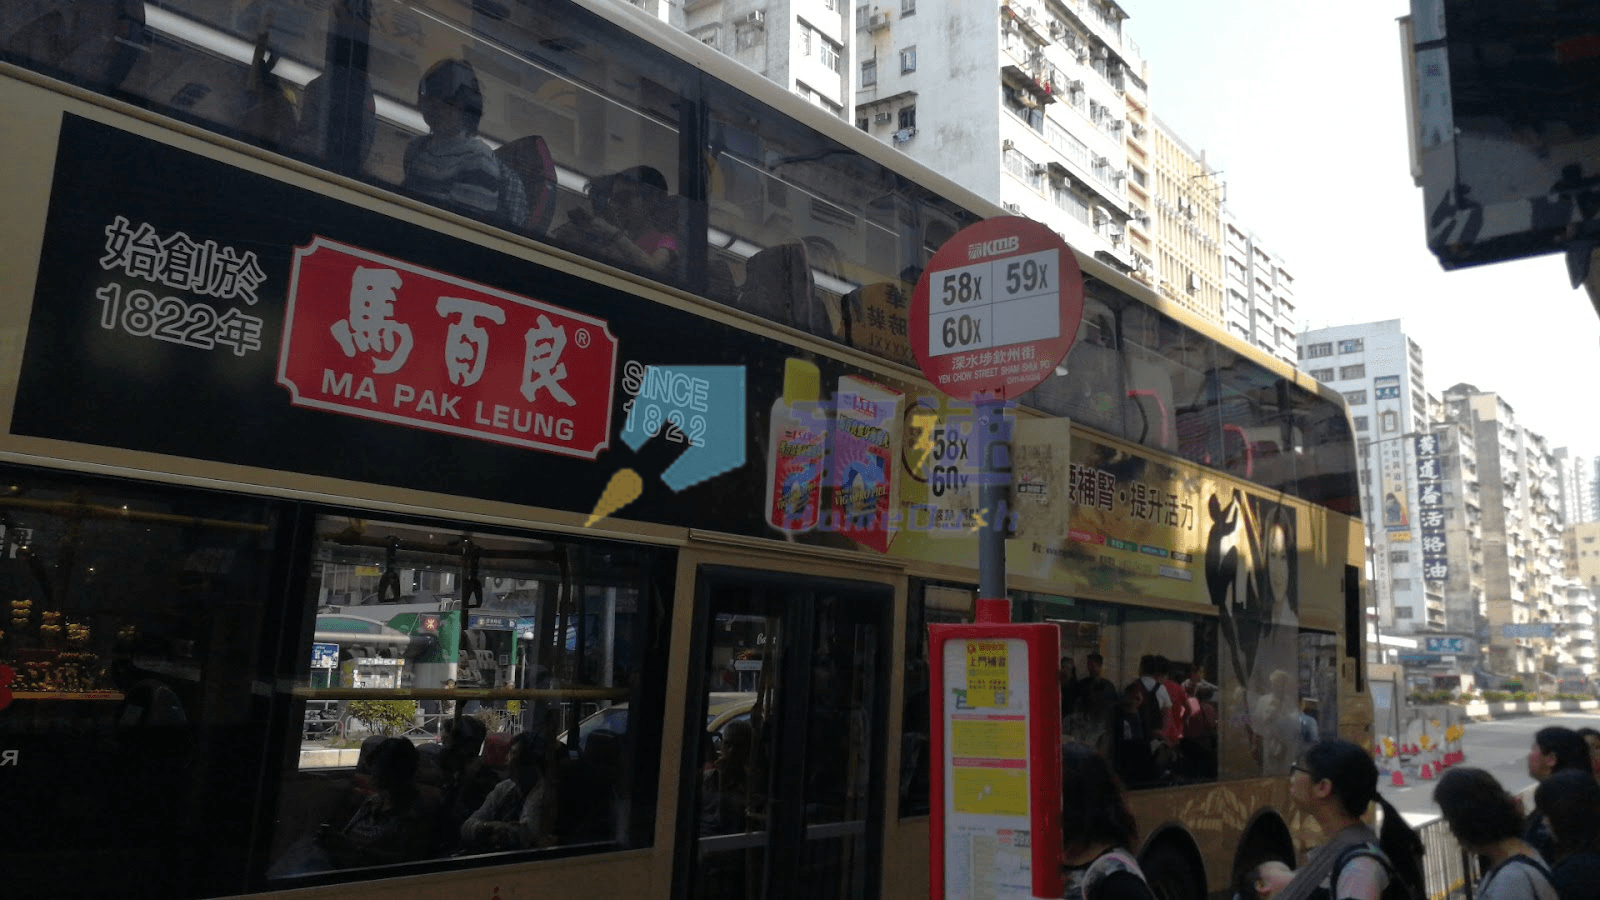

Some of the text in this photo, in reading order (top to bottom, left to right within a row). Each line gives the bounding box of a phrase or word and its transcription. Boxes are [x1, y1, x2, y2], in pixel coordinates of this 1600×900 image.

[101, 216, 267, 305] 始創於
[942, 271, 982, 306] 58X
[1006, 259, 1048, 294] 59X
[97, 282, 263, 357] 1822年
[330, 265, 577, 406] 馬百良
[942, 314, 982, 348] 60X
[621, 361, 709, 413] SINCE
[938, 374, 951, 385] YEN
[953, 372, 972, 382] CHOW
[974, 369, 998, 379] STREET
[1001, 366, 1020, 376] SHAM
[1022, 363, 1039, 373] SHUI
[1040, 361, 1051, 371] PO
[321, 368, 575, 441] MA PAK LEUNG
[622, 400, 707, 447] 1822
[932, 429, 968, 462] 58X
[1418, 435, 1449, 579] 黃道益活絡油
